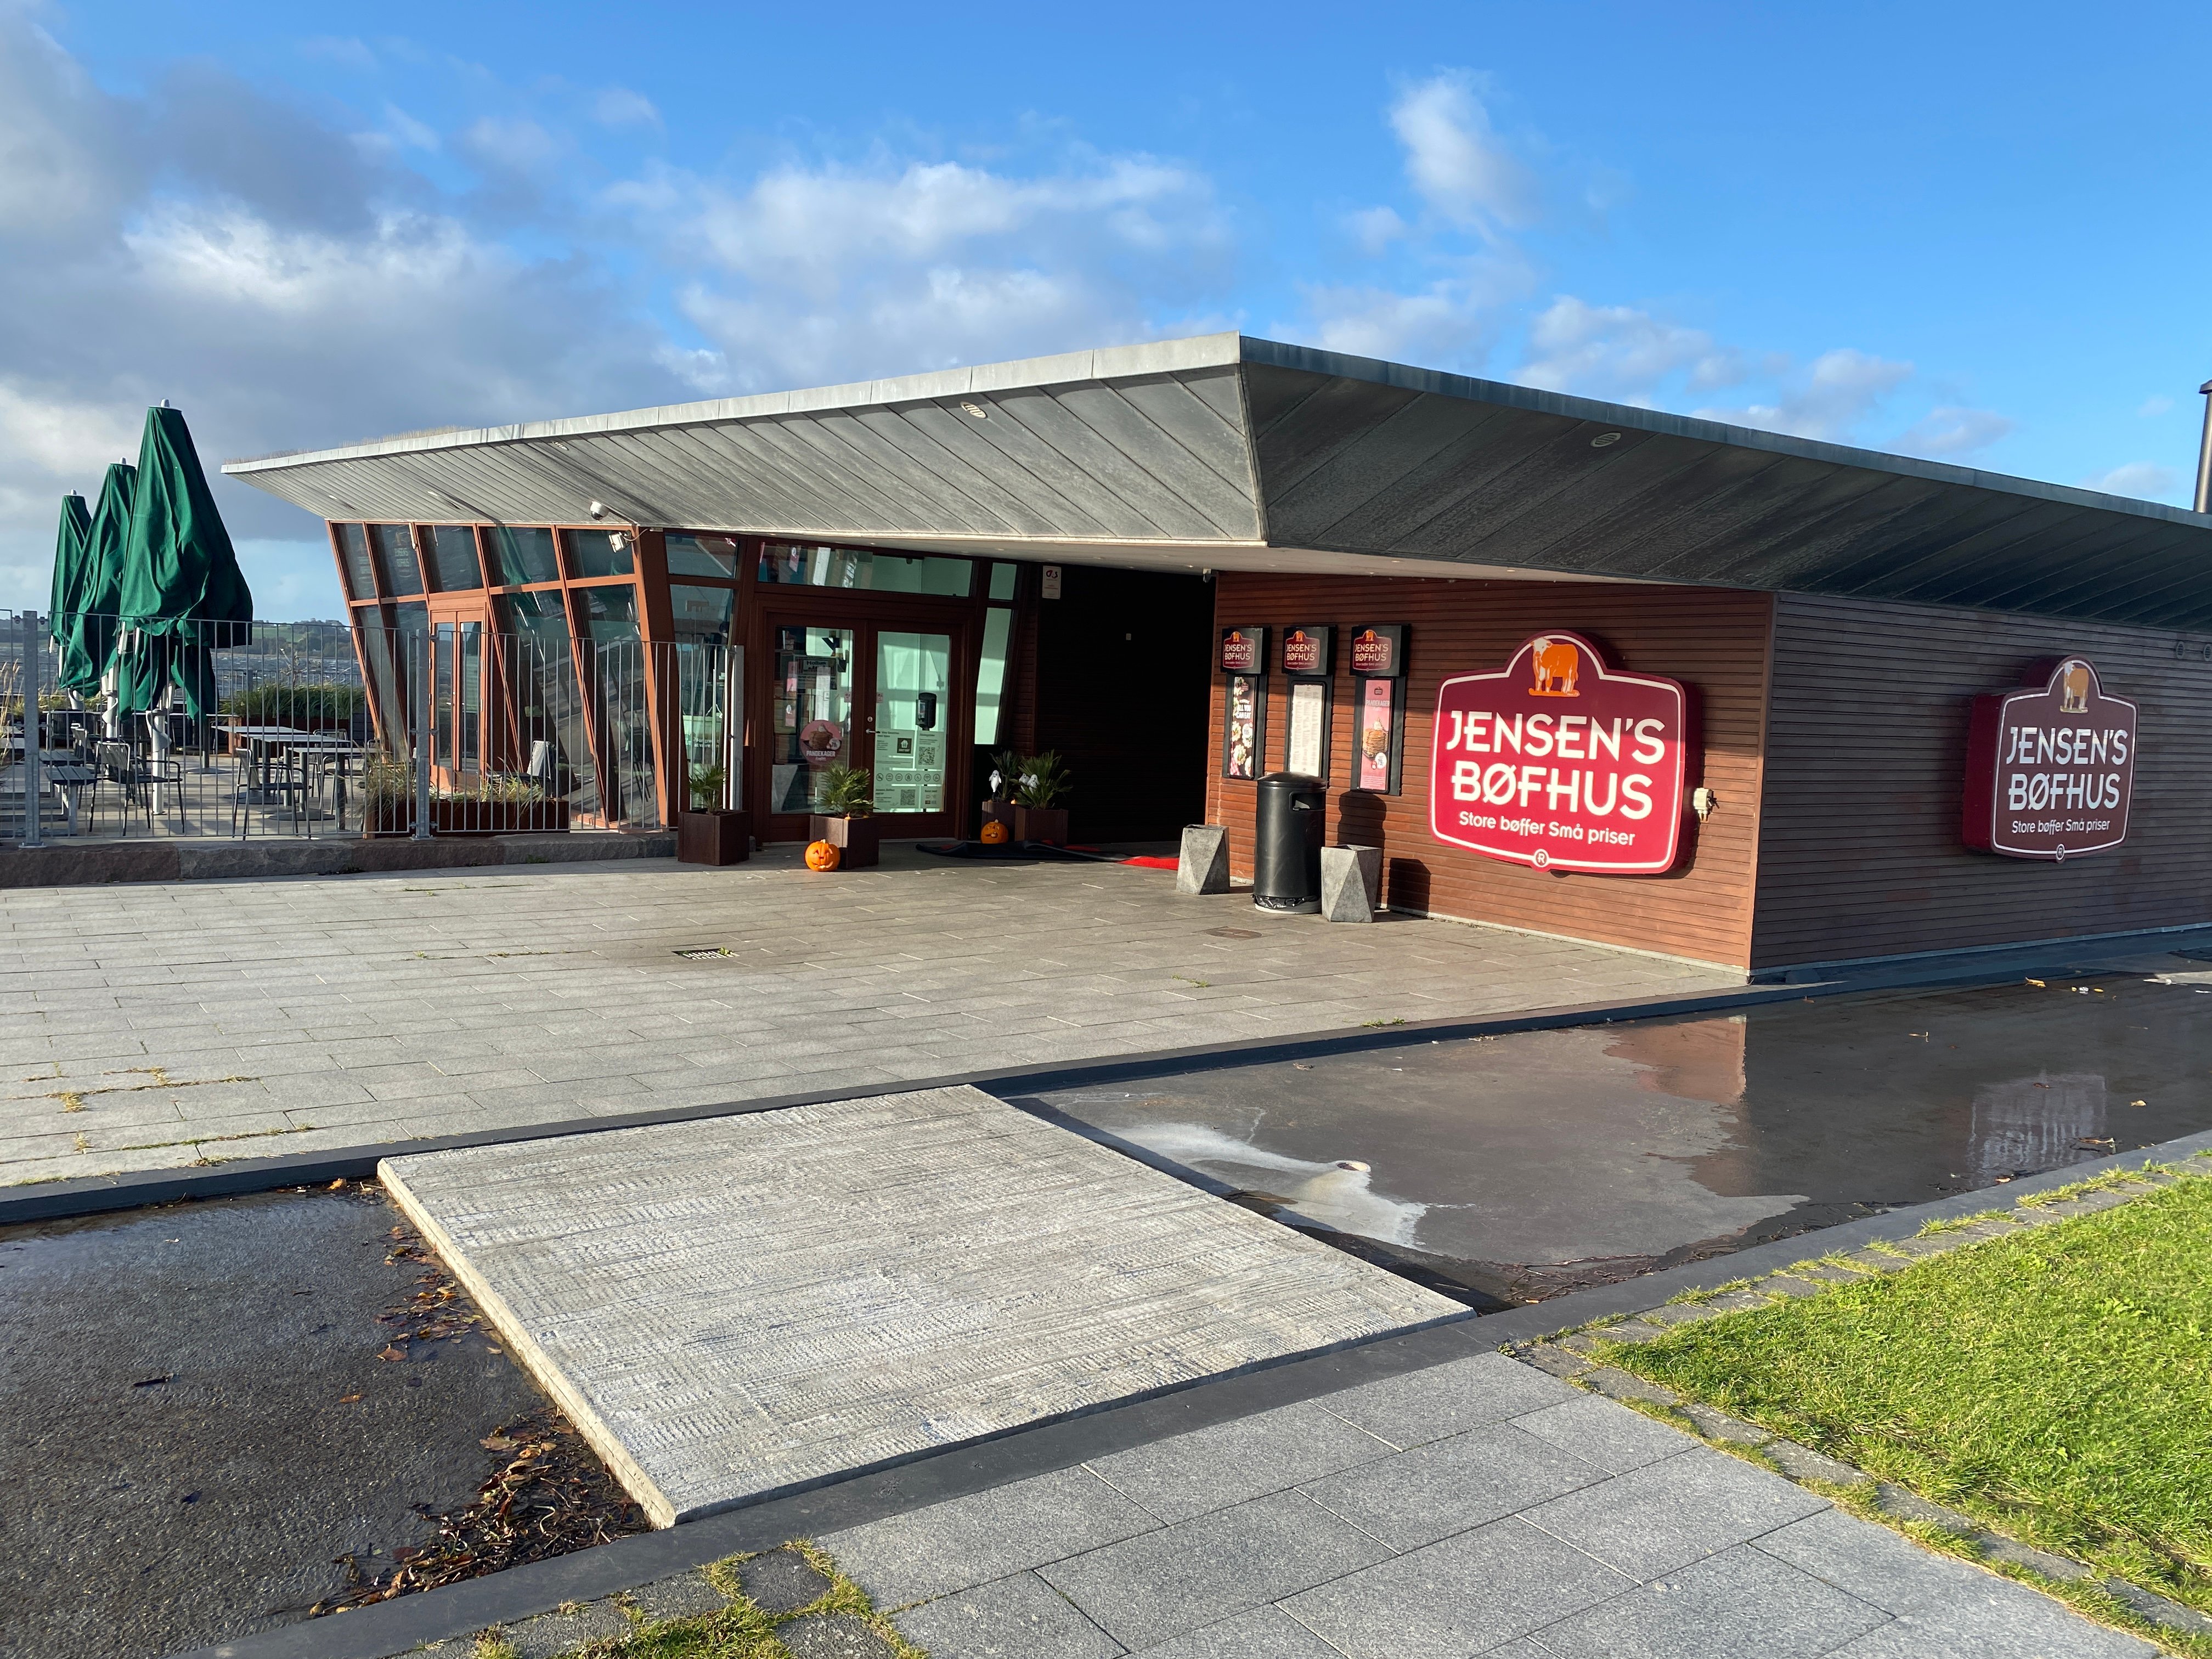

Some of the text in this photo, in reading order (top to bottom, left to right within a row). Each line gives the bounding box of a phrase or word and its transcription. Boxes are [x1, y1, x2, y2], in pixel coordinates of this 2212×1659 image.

[1224, 644, 1252, 652] JENSEN'S
[1286, 644, 1317, 652] JENSEN'S
[1355, 644, 1389, 652] JENSEN'S
[1224, 652, 1251, 661] BØFHUS
[1286, 652, 1315, 661] BØFHUS
[1355, 653, 1387, 662] BØFHUS
[1446, 710, 1666, 765] JENSEN'S
[2006, 726, 2129, 765] JENSEN'S
[1451, 760, 1654, 820] BØFHUS
[2008, 772, 2121, 811] BØFHUS
[1459, 811, 1636, 846] Store bøffer Små priser
[2012, 818, 2111, 835] Store bøffer Små priser
